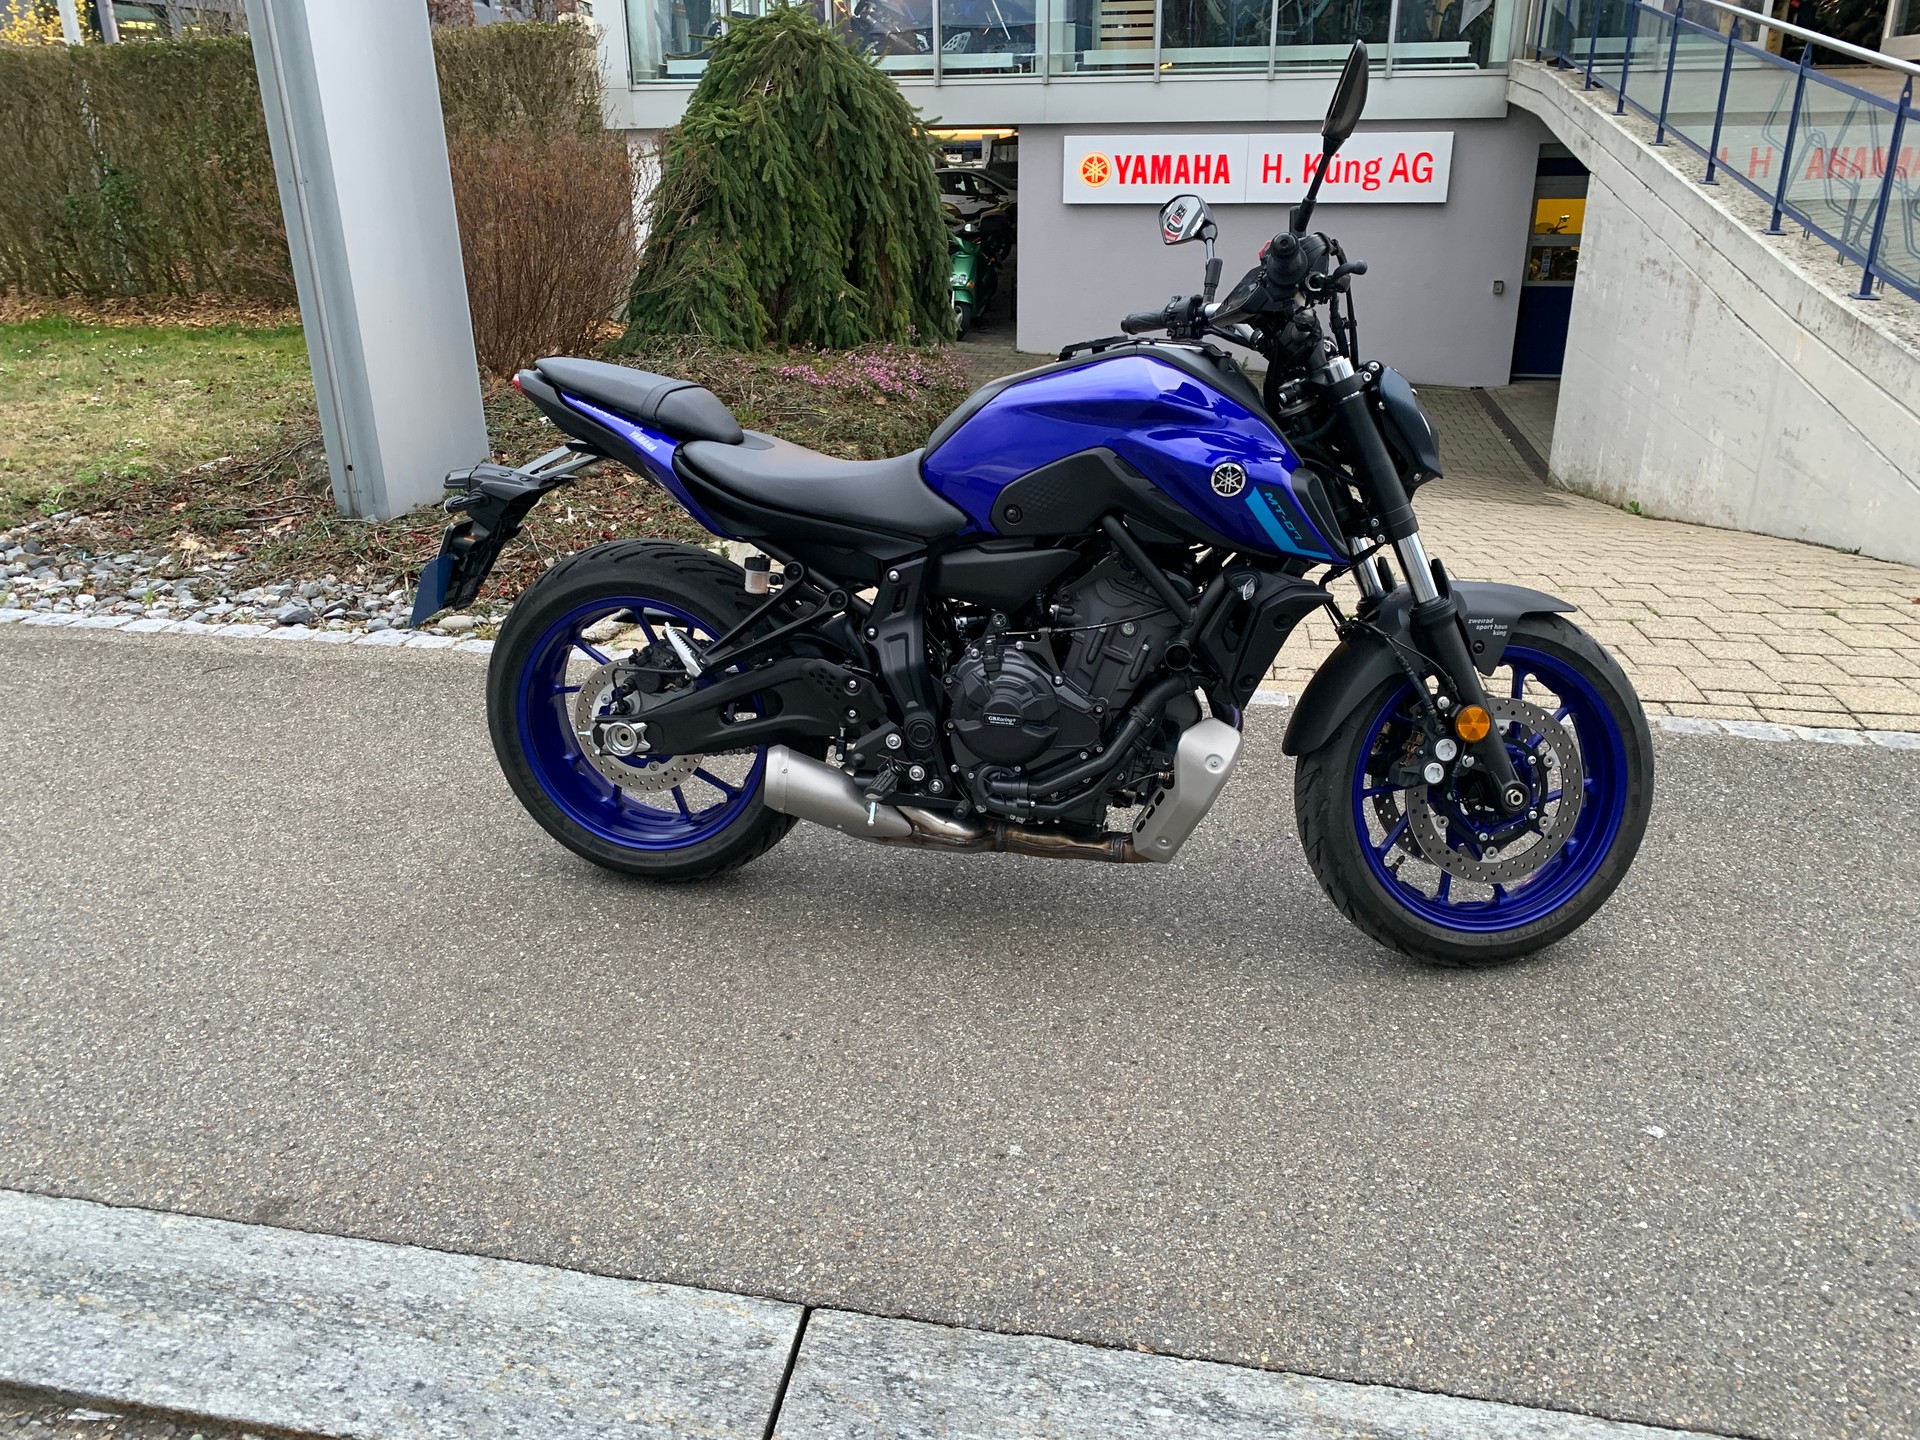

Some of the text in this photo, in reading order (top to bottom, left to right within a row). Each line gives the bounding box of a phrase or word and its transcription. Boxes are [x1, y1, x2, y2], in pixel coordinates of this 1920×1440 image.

[1115, 154, 1230, 184] YAMAHA
[1263, 153, 1291, 184] H.
[1388, 152, 1433, 183] AG
[629, 430, 657, 453] YAMAHA
[1264, 492, 1303, 540] MT-07
